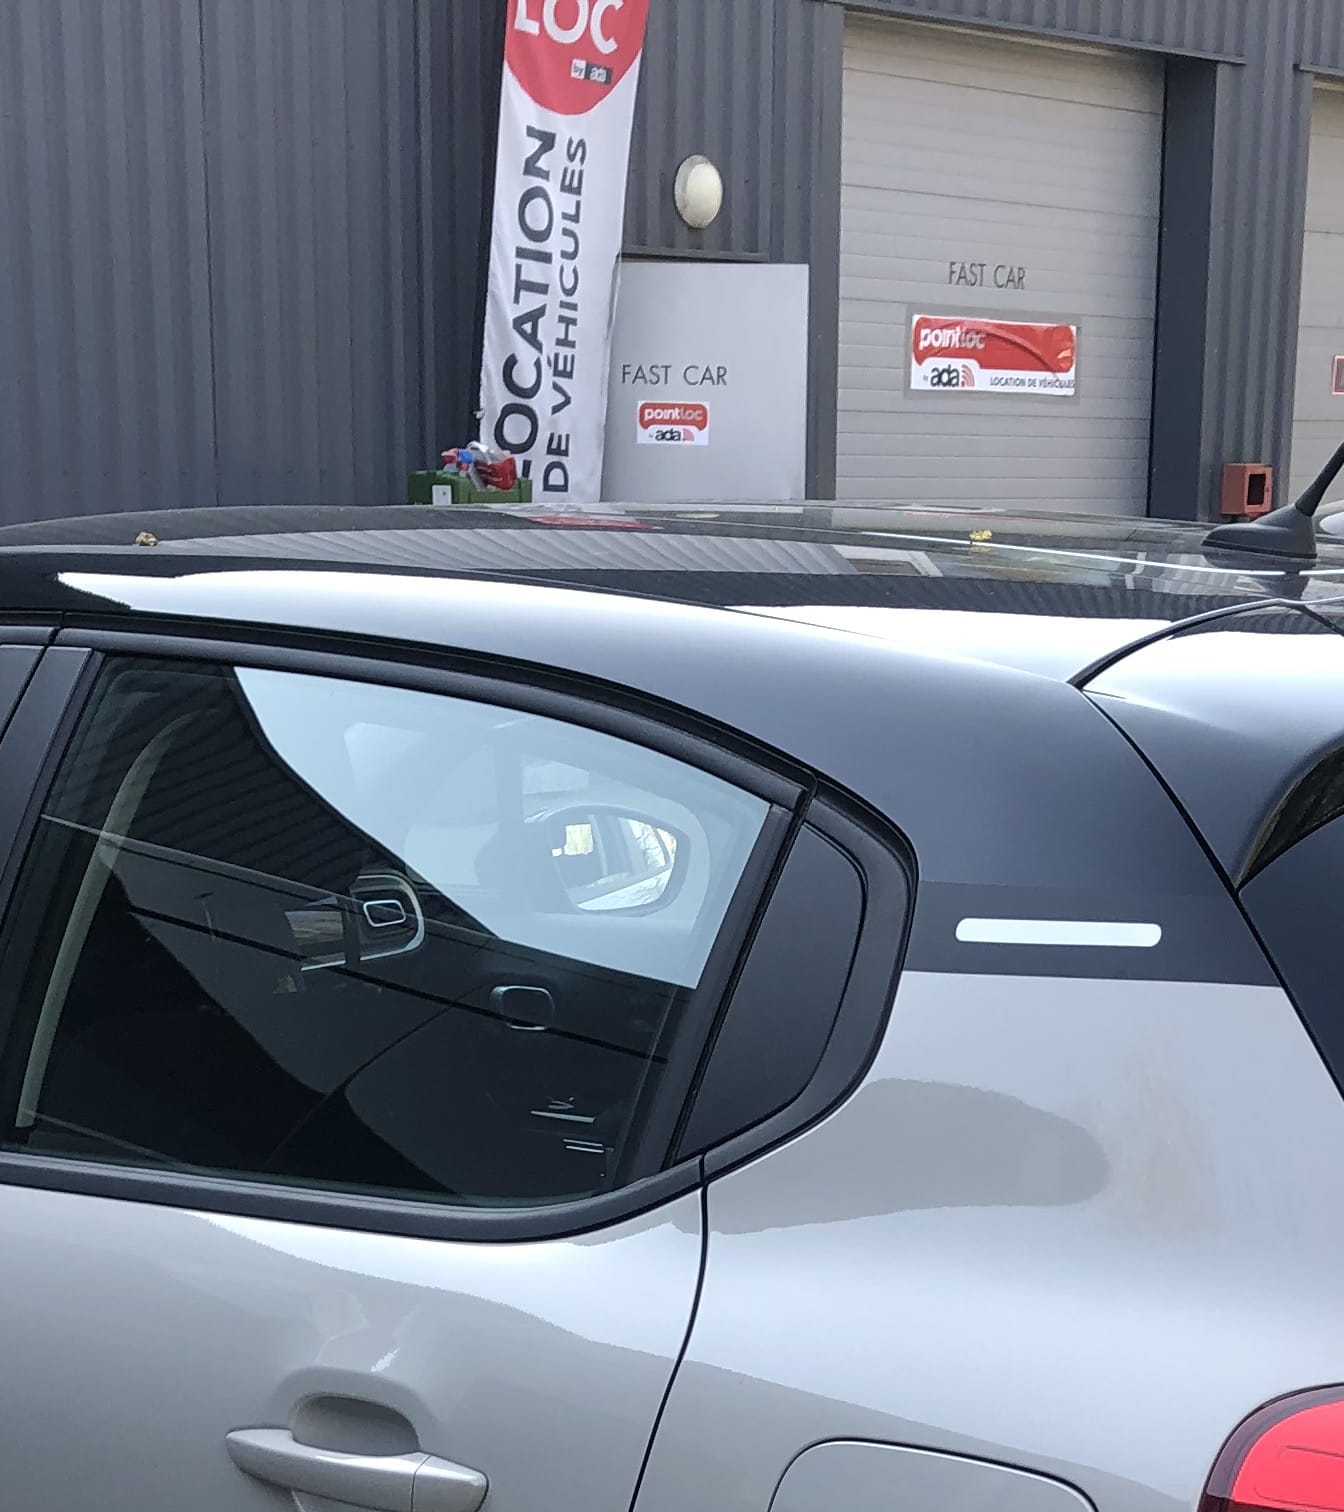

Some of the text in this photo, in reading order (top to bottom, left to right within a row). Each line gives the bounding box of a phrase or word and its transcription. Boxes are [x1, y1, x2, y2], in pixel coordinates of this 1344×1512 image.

[514, 0, 624, 54] LOC
[949, 261, 1026, 290] FAST CAR
[542, 135, 588, 493] DE VÉHICULES
[621, 364, 728, 386] FAST CAR
[930, 364, 960, 388] ada
[990, 376, 1026, 388] LOCATION
[1027, 377, 1037, 389] DE
[654, 428, 682, 441] ada
